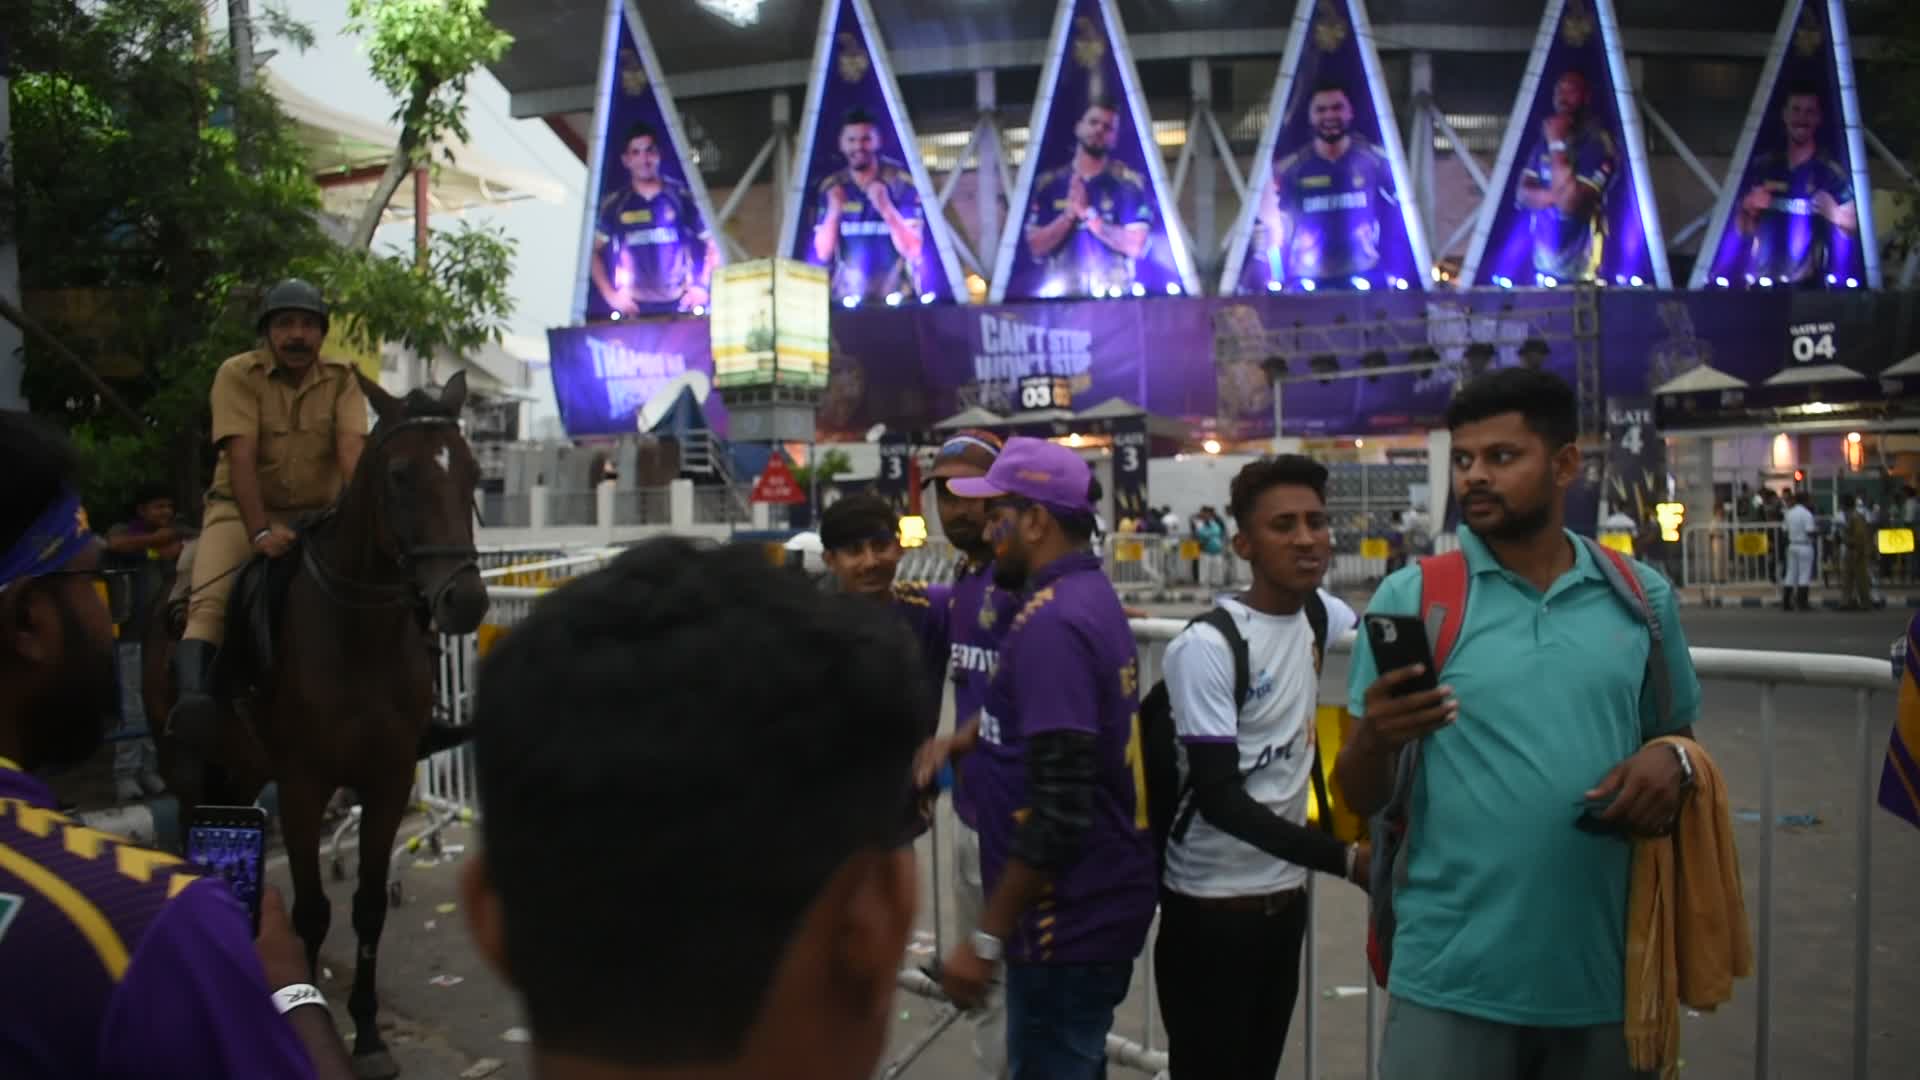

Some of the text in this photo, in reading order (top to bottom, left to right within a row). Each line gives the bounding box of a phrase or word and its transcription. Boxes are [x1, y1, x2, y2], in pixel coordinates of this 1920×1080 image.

[979, 312, 1092, 353] CAN'T STOP
[1792, 333, 1837, 361] 04
[1022, 386, 1051, 408] 03
[1621, 426, 1645, 455] 4
[888, 456, 902, 480] 3
[1122, 445, 1139, 472] 3
